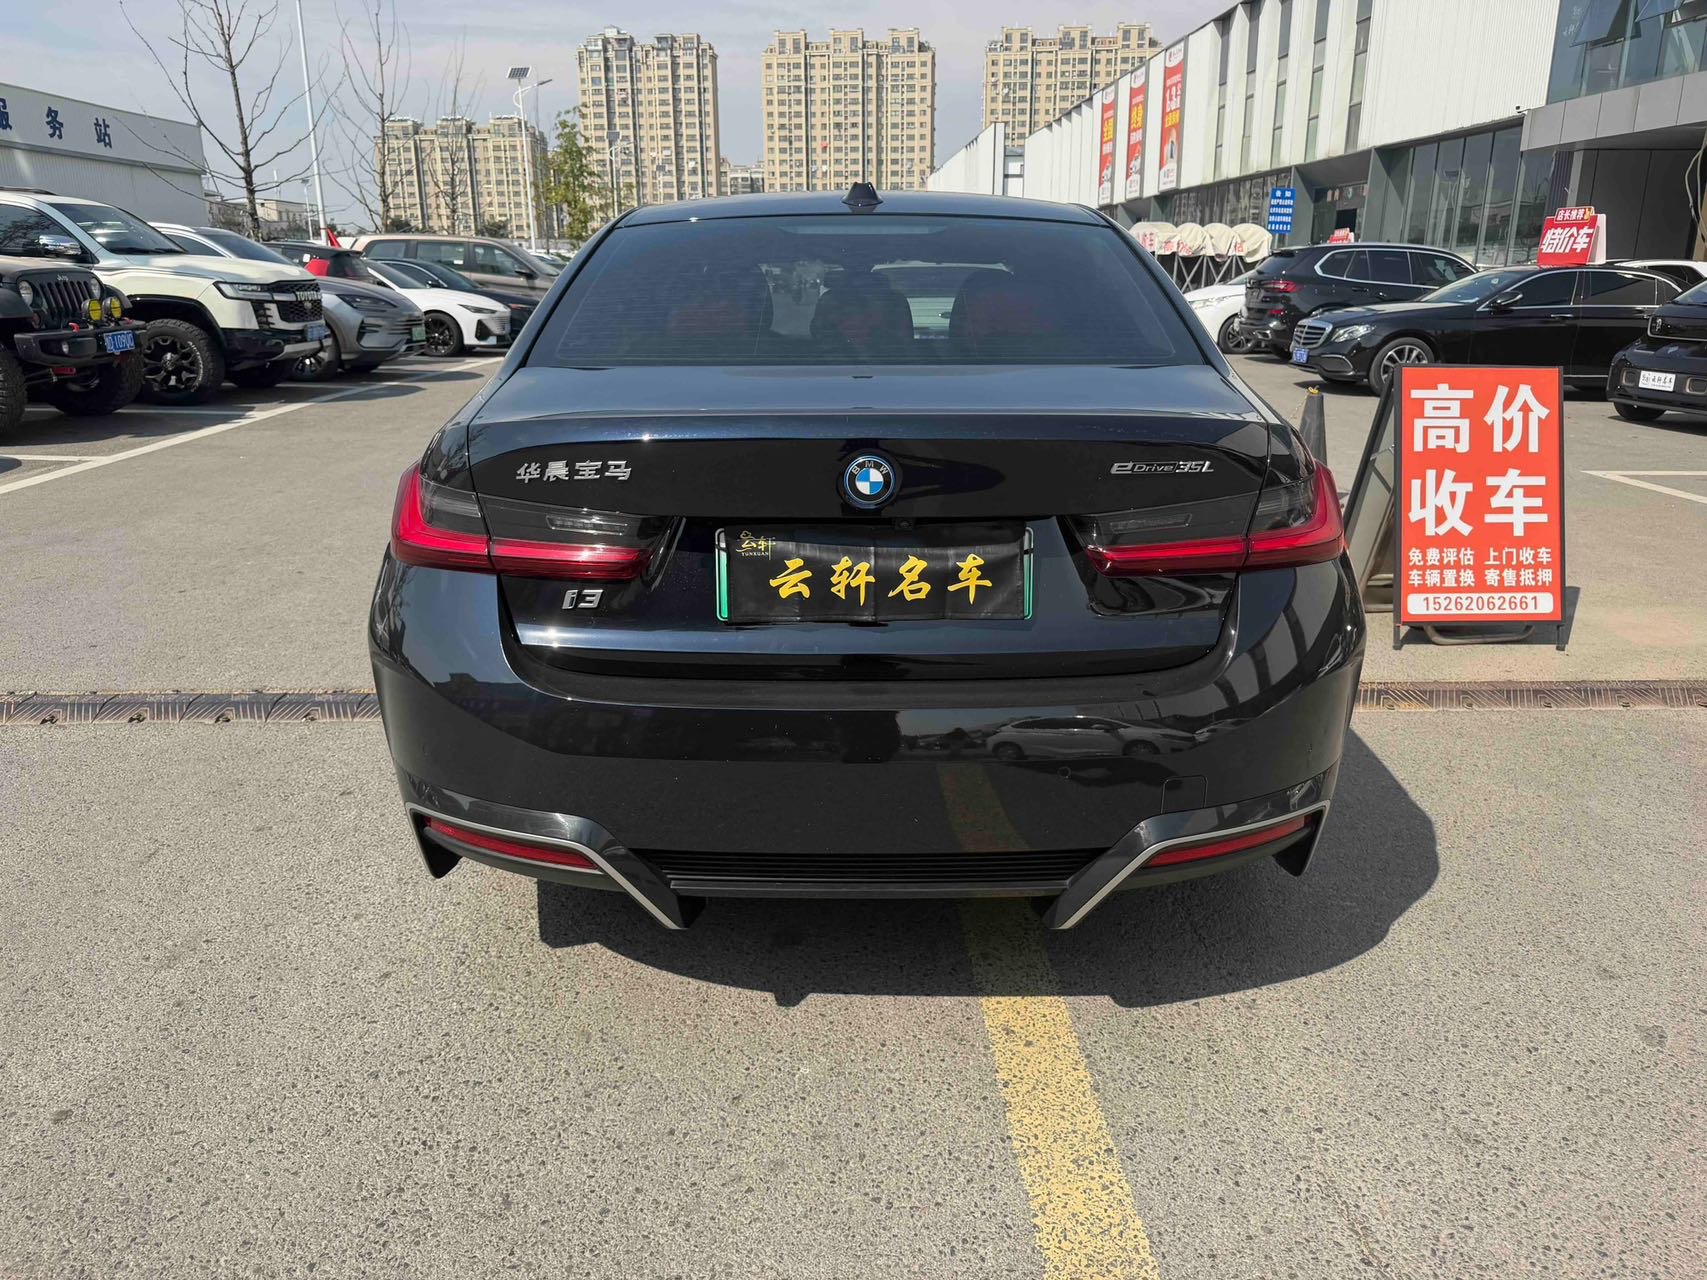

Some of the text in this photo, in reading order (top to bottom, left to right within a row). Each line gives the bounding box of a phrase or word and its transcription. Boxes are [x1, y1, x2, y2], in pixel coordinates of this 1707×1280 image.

[1557, 208, 1585, 221] 店长推荐
[1540, 226, 1594, 253] 特价车
[1410, 383, 1550, 453] 高价
[516, 460, 632, 483] 华晨宝马
[851, 460, 888, 475] BMW
[1408, 468, 1549, 537] 收车
[1408, 547, 1552, 566] 免费评估 上门收车
[769, 553, 993, 606] 云轩名车
[1408, 568, 1553, 587] 车辆置换 寄售抵押
[562, 589, 604, 610] i3
[1423, 595, 1539, 612] 15262062661
